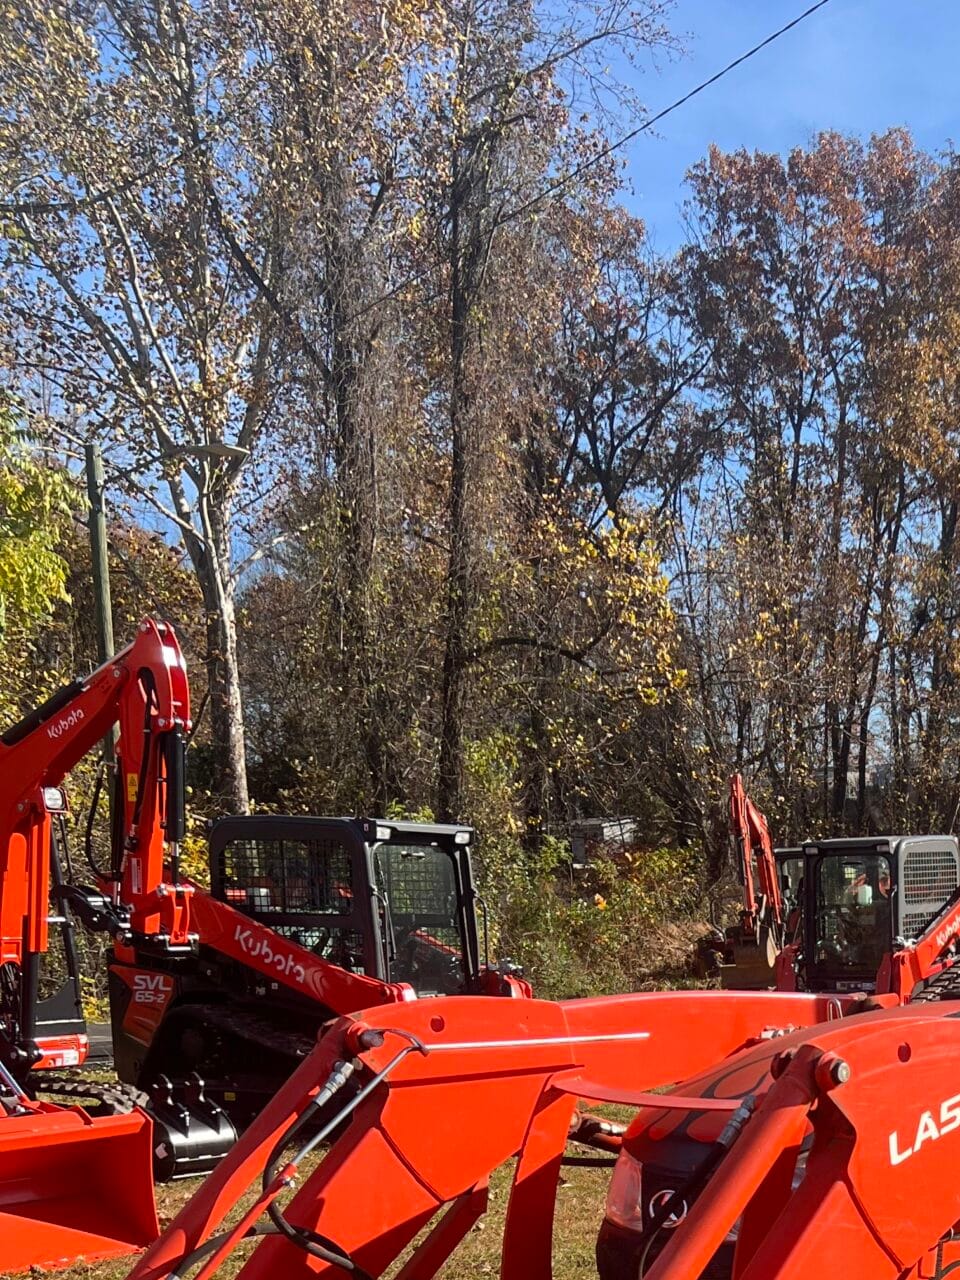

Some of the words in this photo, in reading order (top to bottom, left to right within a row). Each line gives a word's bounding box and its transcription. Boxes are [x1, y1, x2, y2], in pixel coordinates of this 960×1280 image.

[47, 709, 85, 738] Kubota
[234, 924, 306, 983] Kubota
[133, 975, 172, 990] SVL
[135, 991, 165, 1003] 65-2
